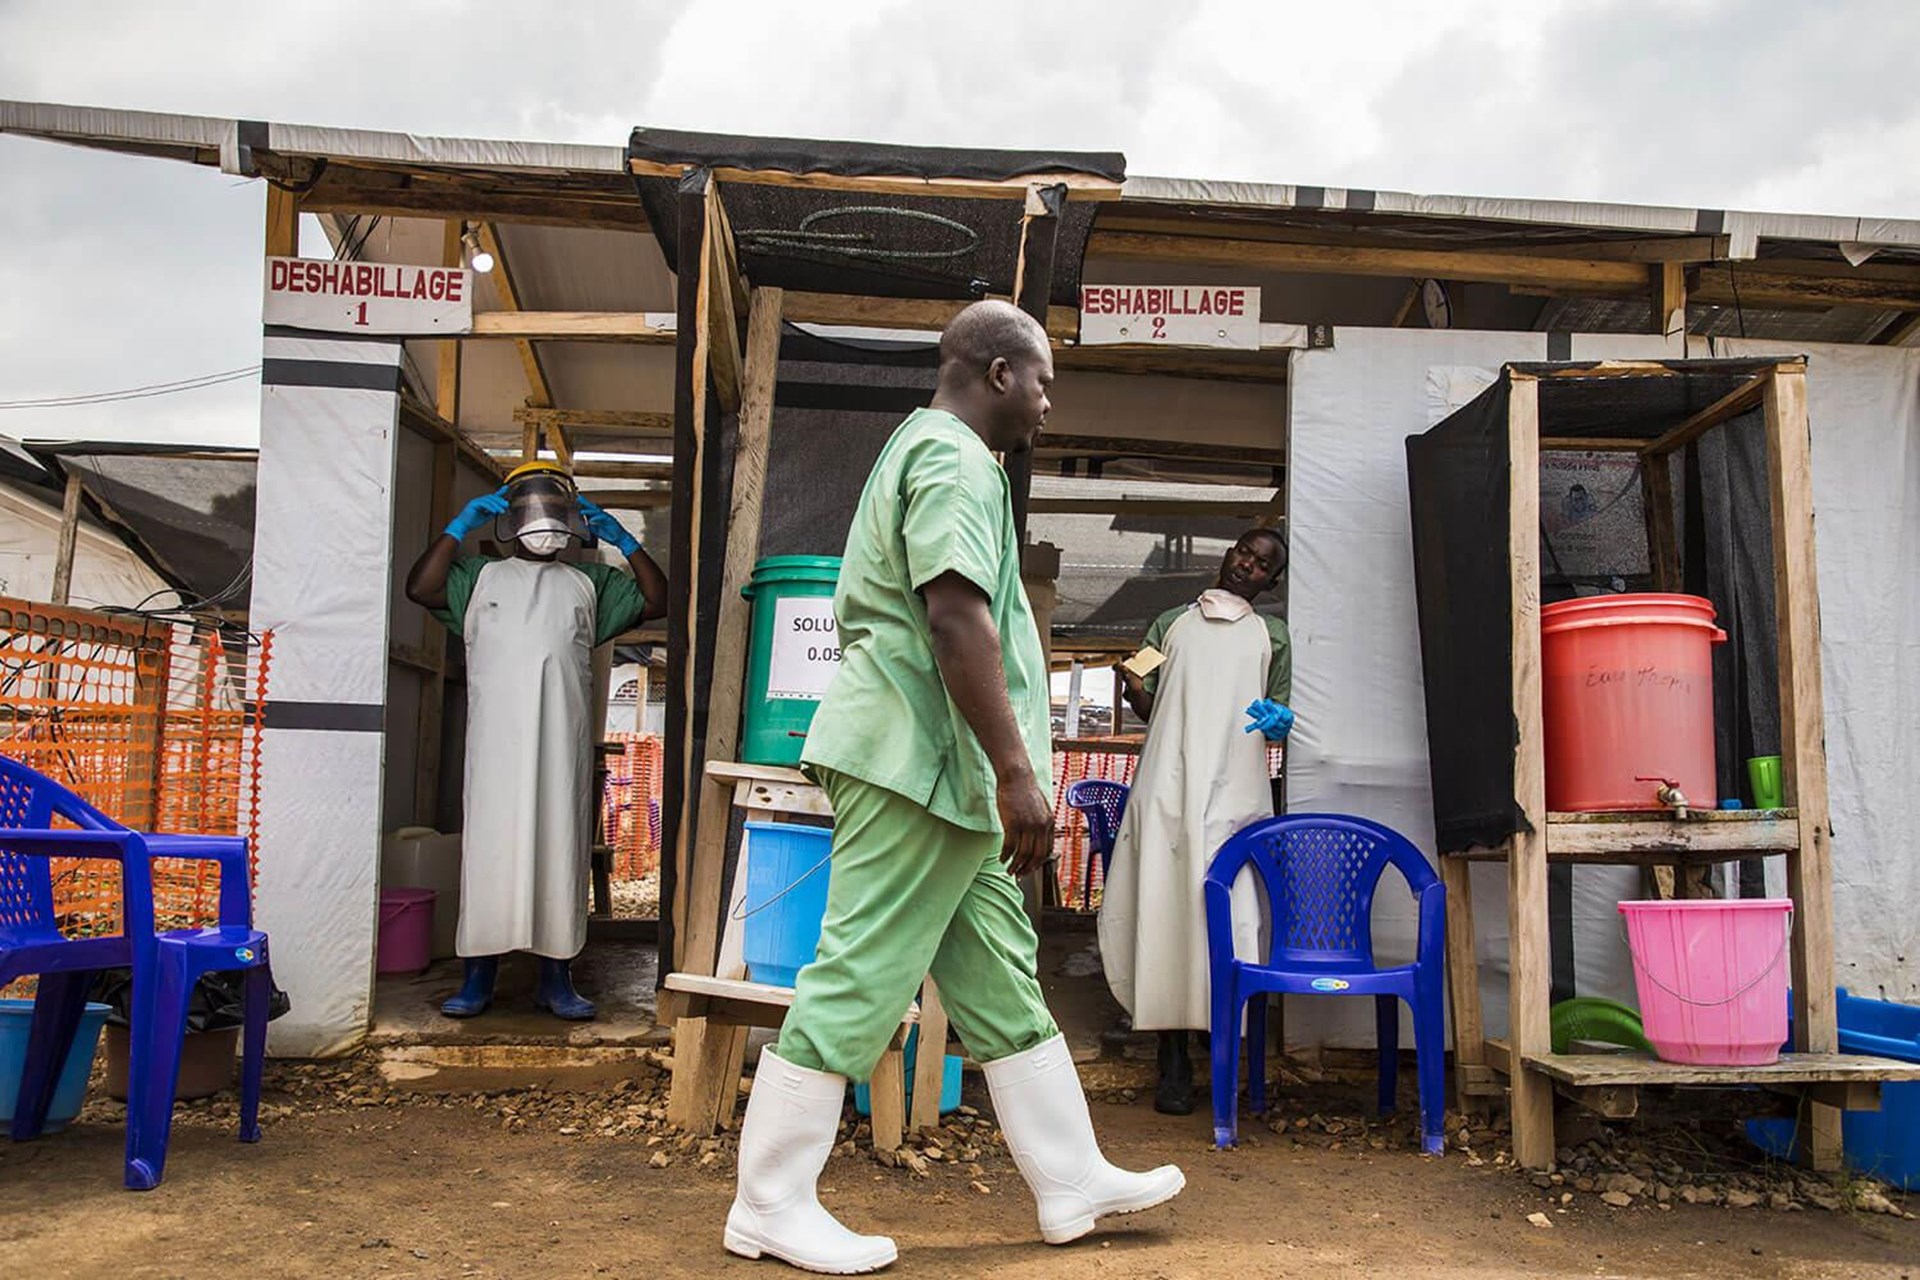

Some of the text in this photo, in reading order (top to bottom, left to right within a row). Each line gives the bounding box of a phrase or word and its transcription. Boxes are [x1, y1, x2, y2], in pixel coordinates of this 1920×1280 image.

[271, 260, 464, 302] DESHABILLAGE
[354, 301, 369, 326] 1
[1080, 288, 1245, 316] ESHABILLAGE
[1151, 317, 1167, 339] 2
[807, 646, 842, 662] 0.05
